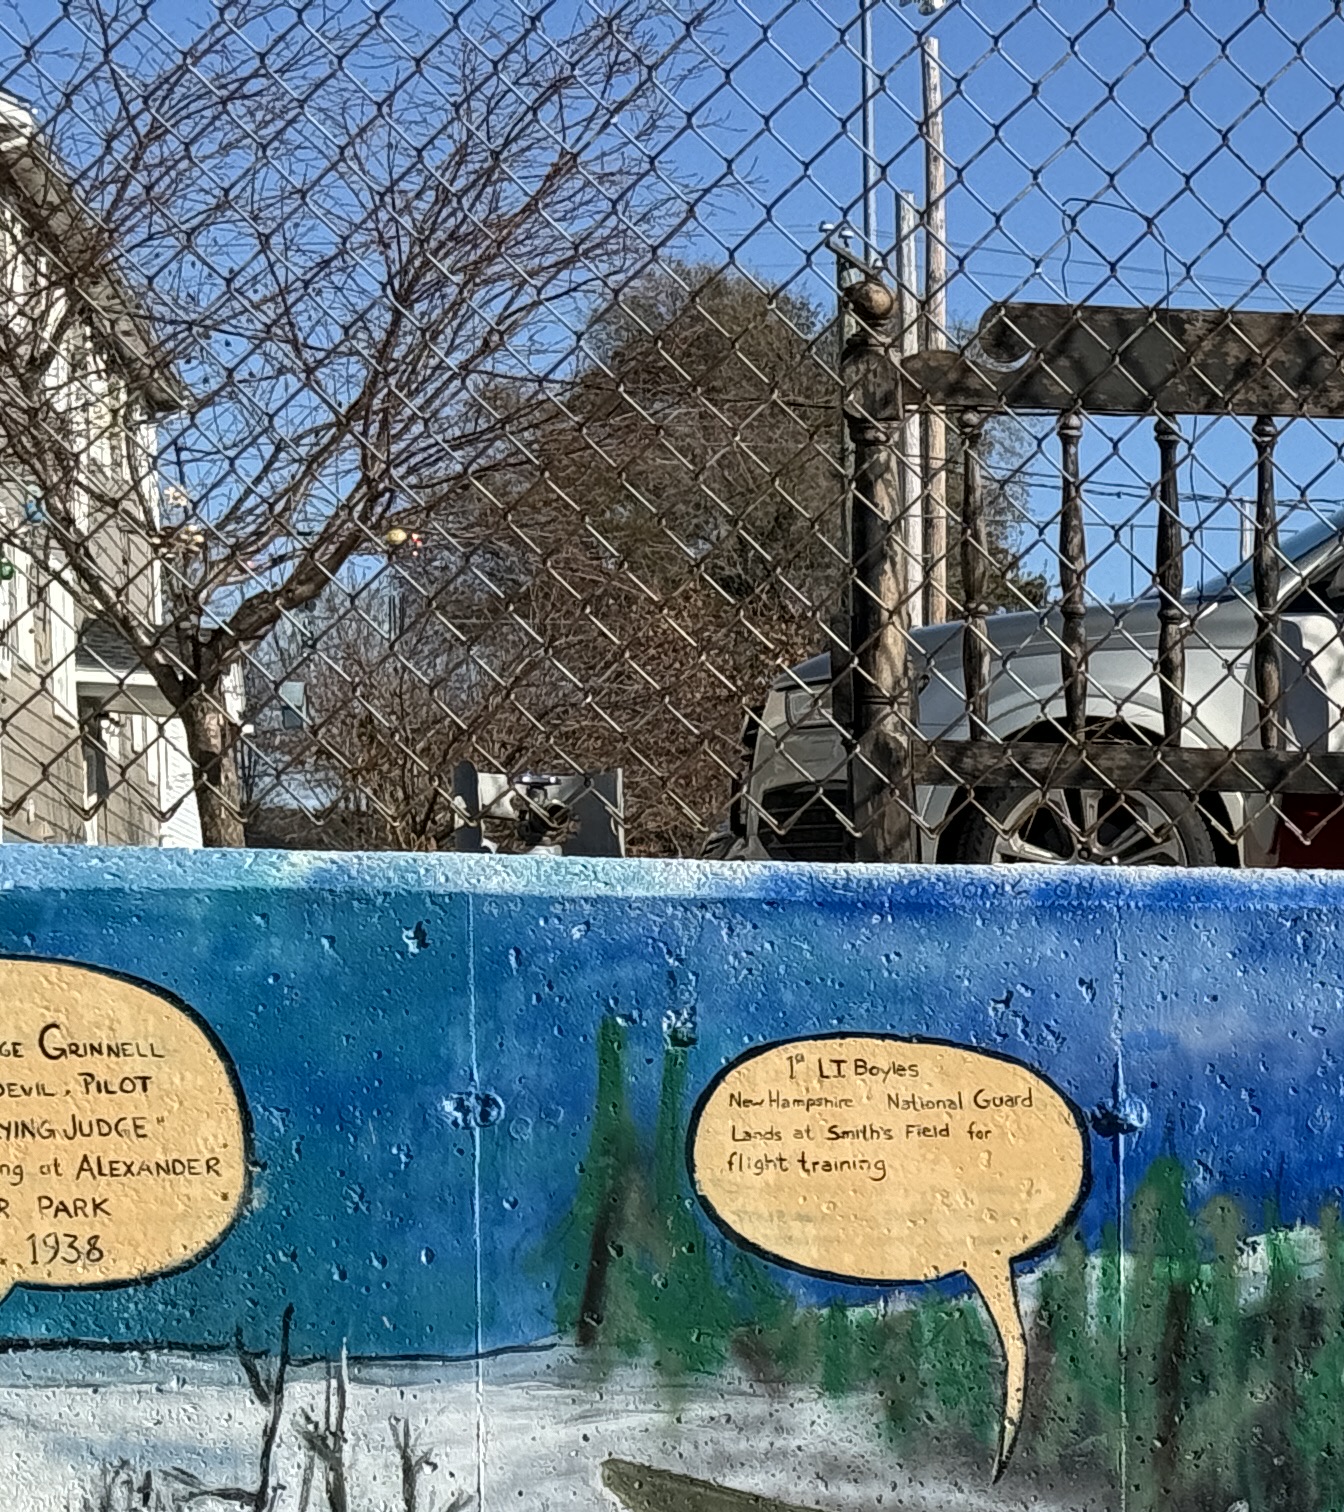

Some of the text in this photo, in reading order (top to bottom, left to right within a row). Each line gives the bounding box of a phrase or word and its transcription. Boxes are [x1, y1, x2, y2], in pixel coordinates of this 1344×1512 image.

[39, 1023, 165, 1060] GRINNELL
[854, 1057, 919, 1083] Boyles
[78, 1073, 152, 1095] PILOT
[729, 1087, 1033, 1112] New Hampshire National Guard
[731, 1122, 993, 1142] Lands at Smith's Field for
[40, 1158, 63, 1177] at
[76, 1154, 222, 1181] ALEXANDER
[727, 1151, 886, 1181] flight training
[38, 1196, 112, 1219] PARK
[27, 1232, 103, 1264] 1938
